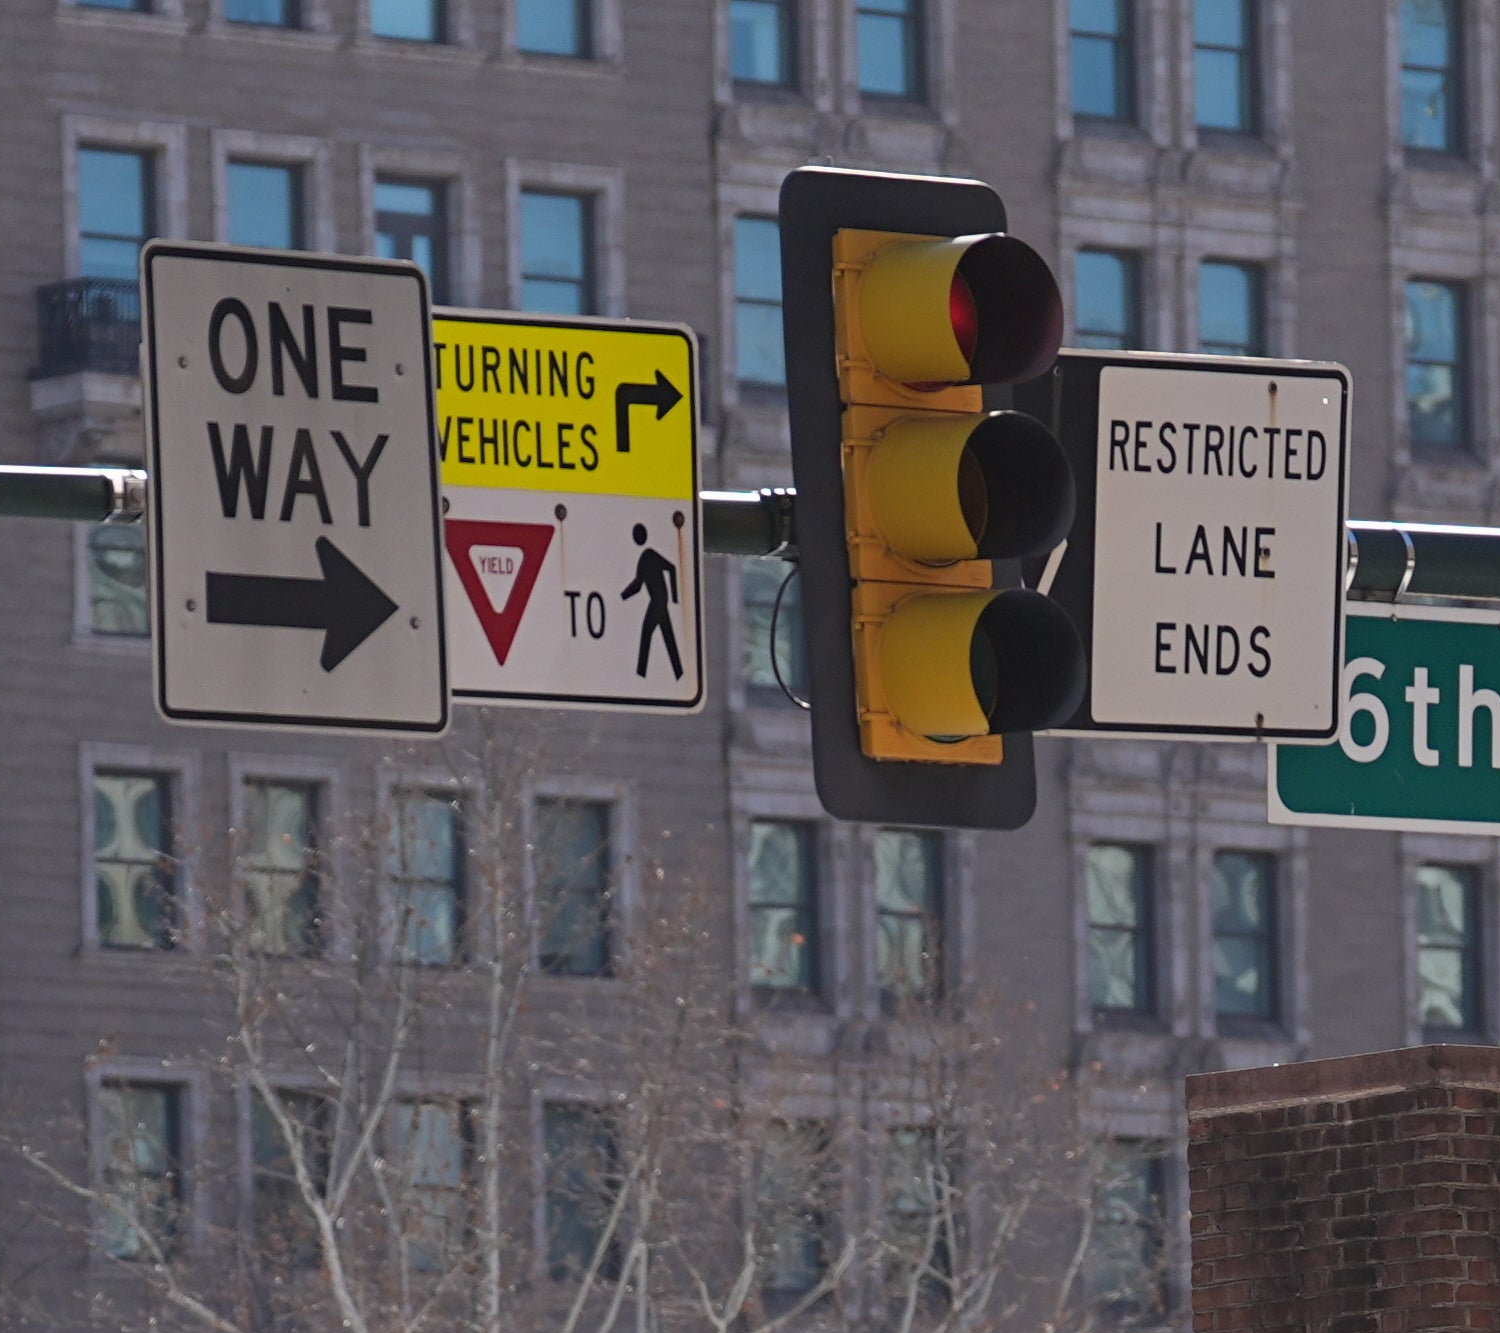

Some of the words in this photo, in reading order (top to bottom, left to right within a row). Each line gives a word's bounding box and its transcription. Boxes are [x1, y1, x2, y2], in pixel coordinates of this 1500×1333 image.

[207, 297, 380, 404] ONE
[433, 342, 596, 400] TURNING
[437, 415, 600, 472] VEHICLES
[1109, 419, 1328, 482] RESTRICTED
[206, 421, 390, 528] WAY
[478, 556, 515, 576] YIELD
[1154, 521, 1278, 580] LANE
[563, 590, 607, 641] TO
[1154, 622, 1273, 679] ENDS
